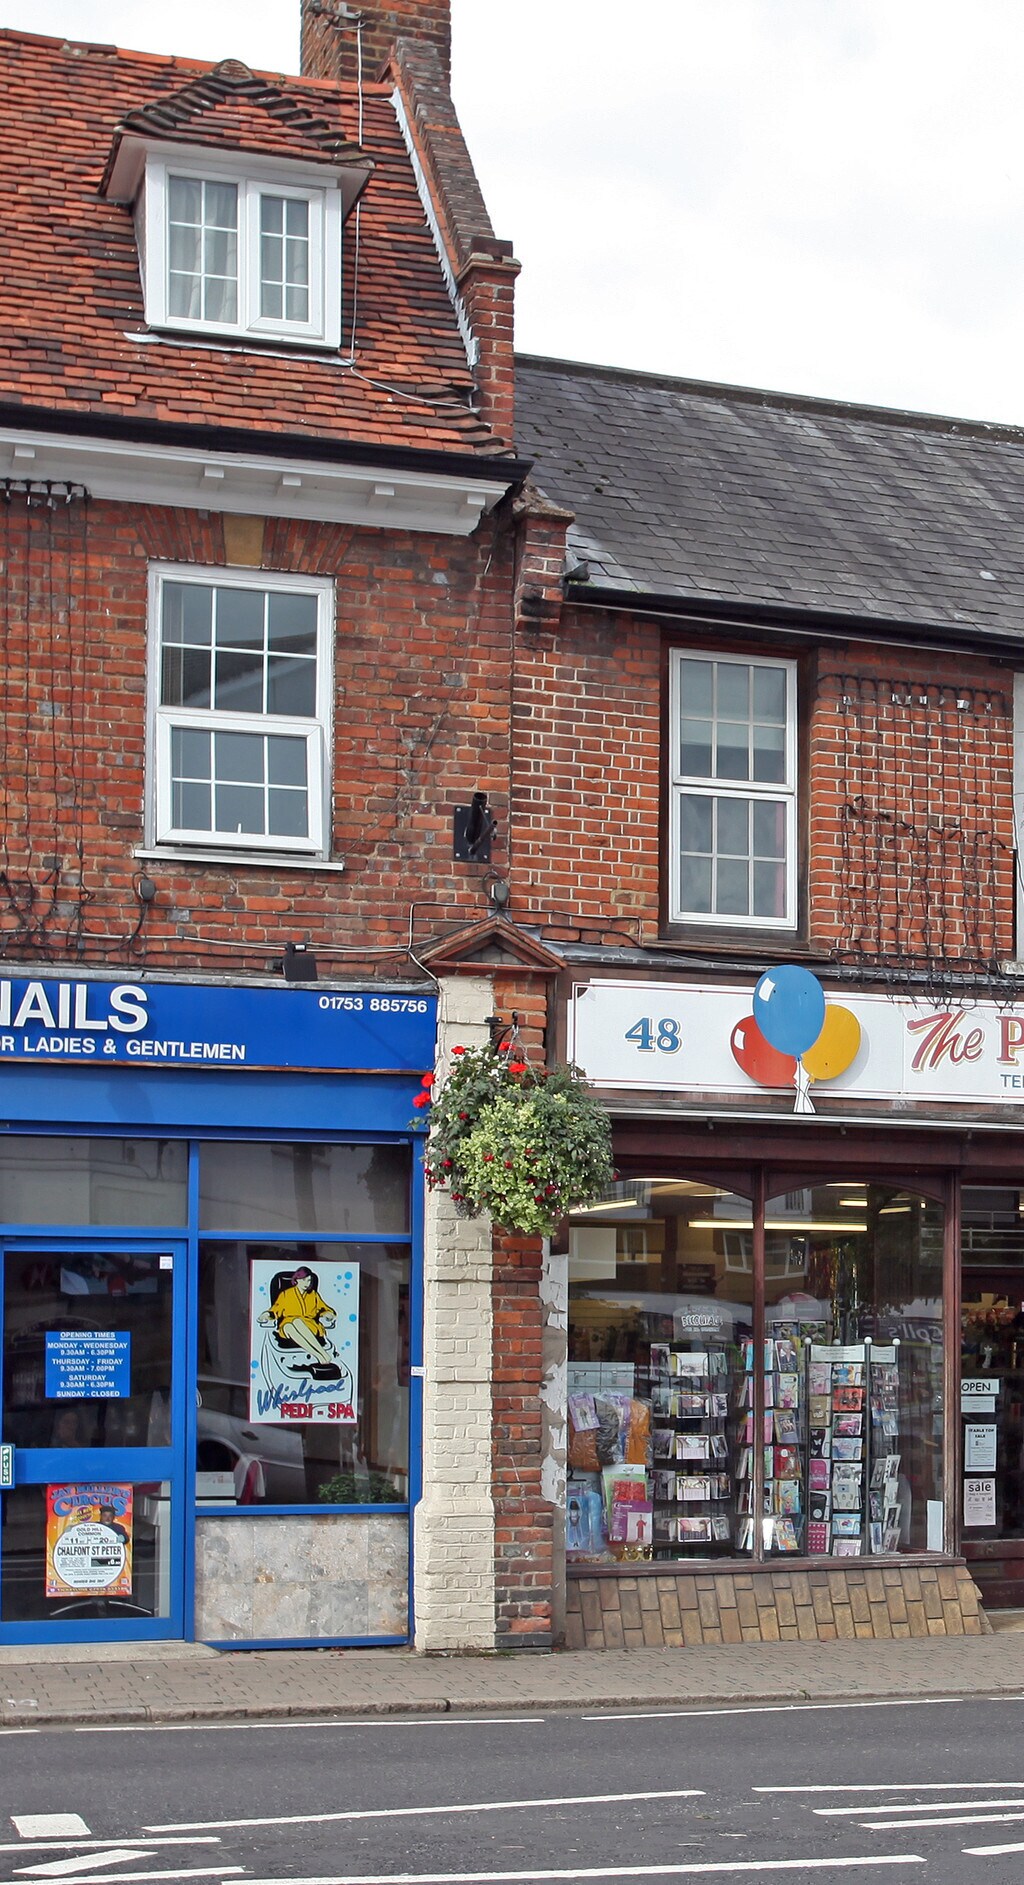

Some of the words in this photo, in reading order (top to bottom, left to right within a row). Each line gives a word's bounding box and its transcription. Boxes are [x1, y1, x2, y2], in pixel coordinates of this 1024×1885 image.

[319, 996, 363, 1011] 01753
[370, 998, 427, 1013] 885756
[624, 1017, 682, 1054] 48
[906, 1010, 985, 1072] The
[24, 1036, 96, 1054] LADIES
[103, 1038, 117, 1054] &
[126, 1039, 245, 1060] GENTLEMEN
[961, 1382, 991, 1392] OPEN
[256, 1379, 345, 1416] Whirlpool
[281, 1402, 313, 1419] PEDI
[328, 1402, 355, 1419] SPA
[968, 1482, 992, 1492] sale
[53, 1493, 128, 1517] CIRCUS
[57, 1546, 90, 1555] CHALFONT
[91, 1546, 100, 1555] ST
[101, 1546, 121, 1555] PETER
